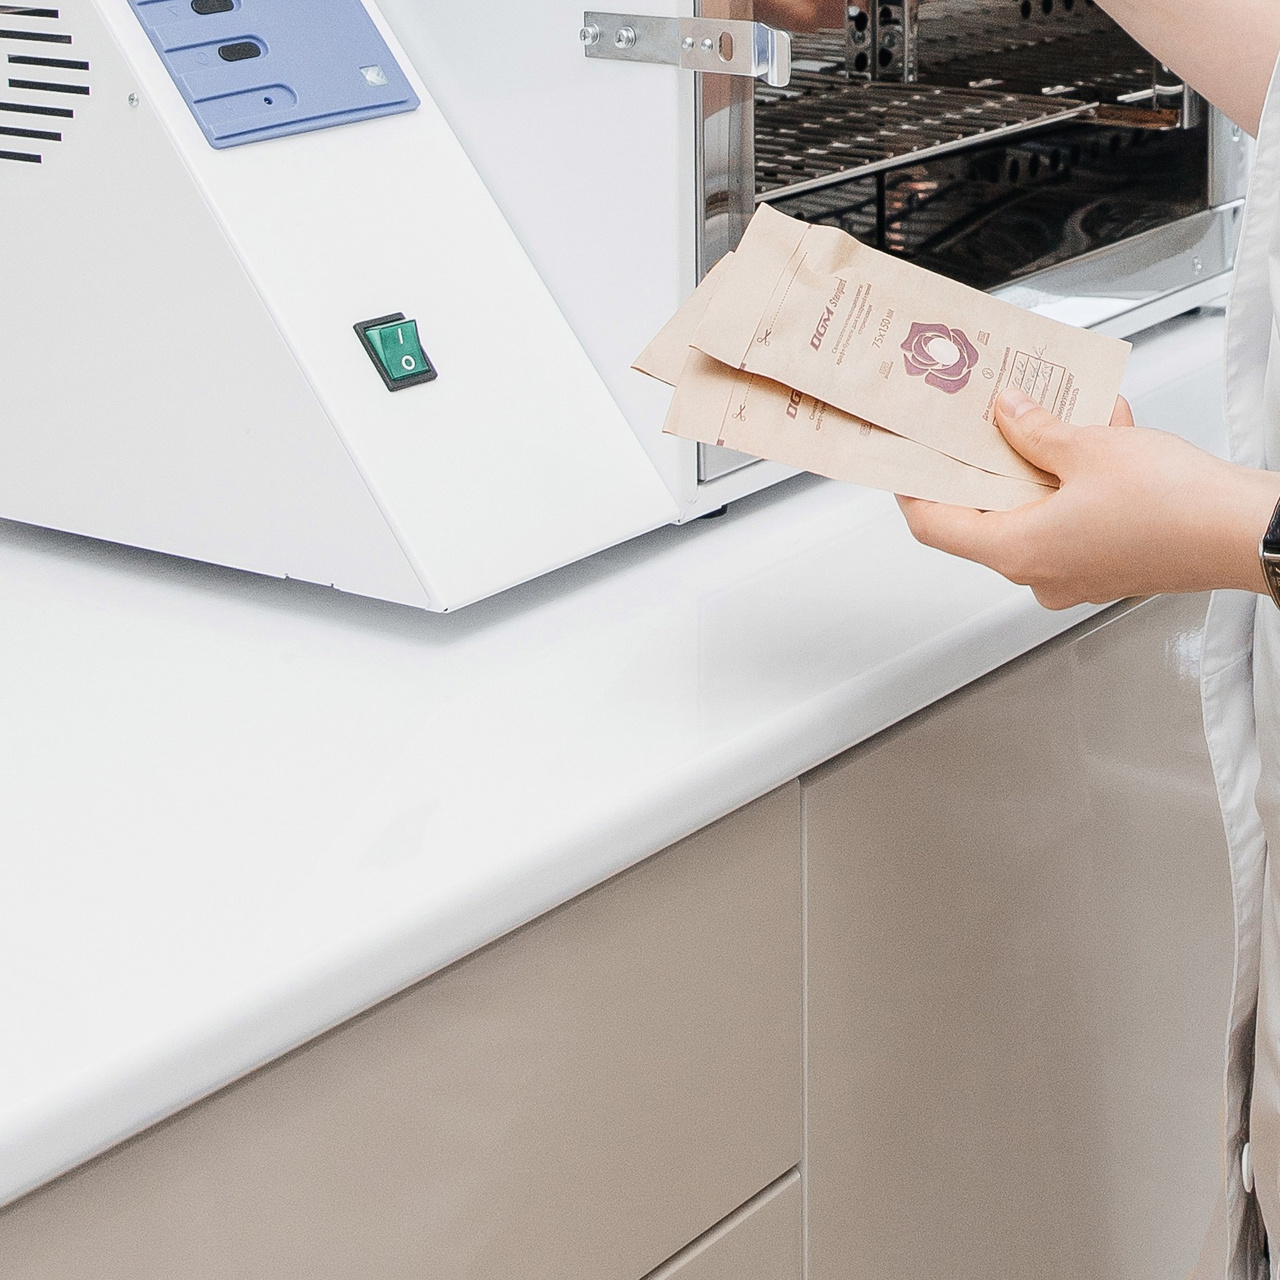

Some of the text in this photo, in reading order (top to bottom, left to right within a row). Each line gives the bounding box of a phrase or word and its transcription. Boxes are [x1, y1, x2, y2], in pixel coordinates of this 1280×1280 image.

[810, 305, 834, 351] DGM
[786, 388, 804, 420] DG
[1063, 387, 1080, 424] СПОЛЬЗОВАТЬ
